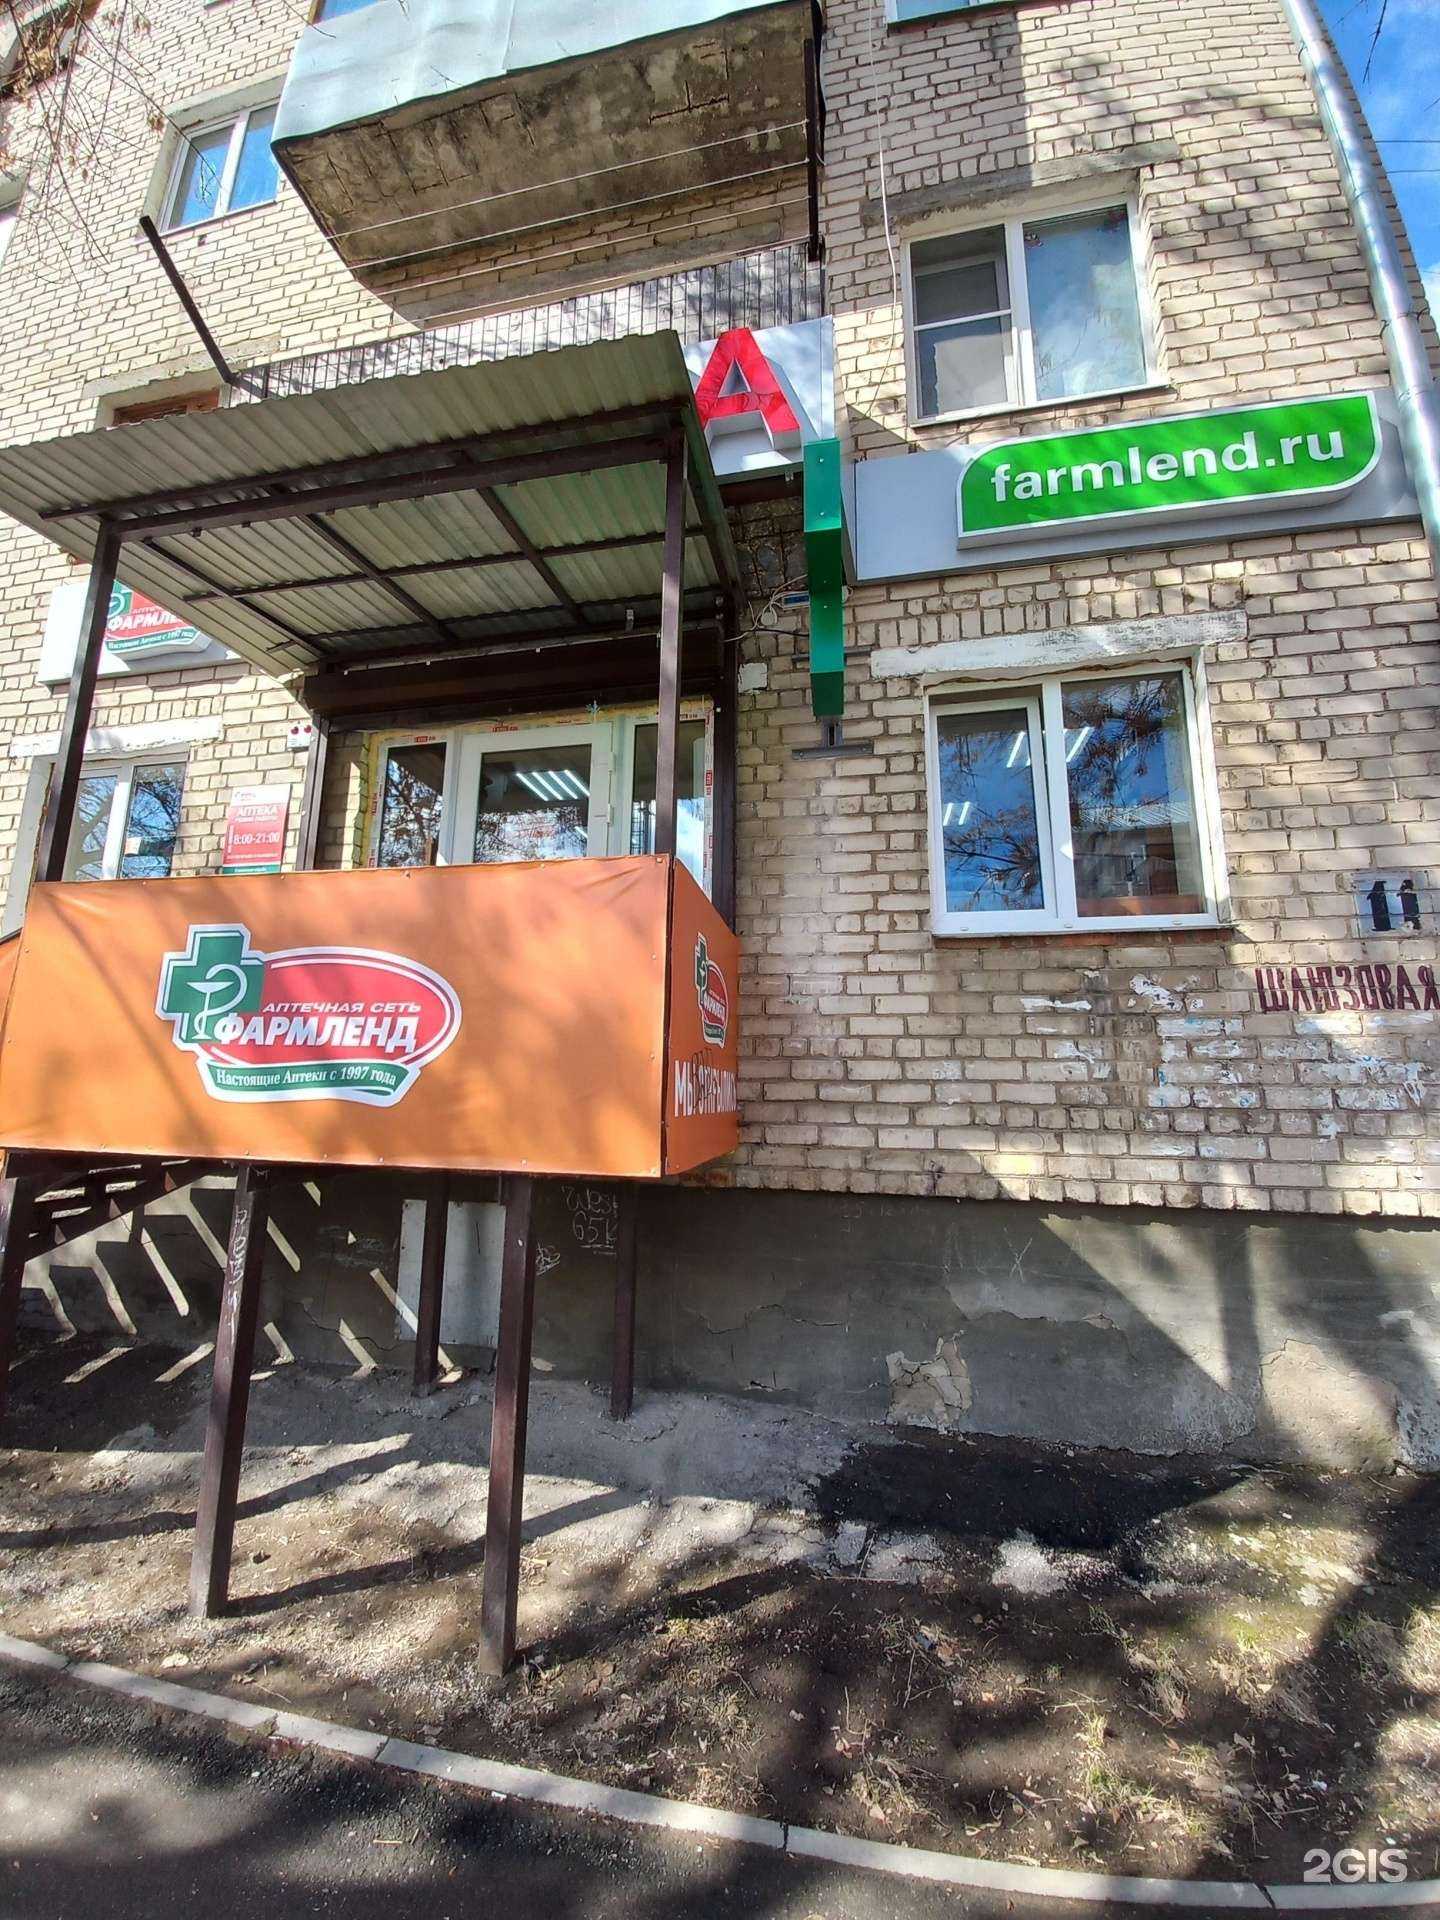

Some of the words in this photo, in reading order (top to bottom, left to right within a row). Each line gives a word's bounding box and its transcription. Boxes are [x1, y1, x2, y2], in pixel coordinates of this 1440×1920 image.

[694, 327, 801, 434] А
[990, 431, 1345, 502] farmlend.ru
[1366, 878, 1424, 932] 11
[263, 1002, 364, 1013] АПТЕЧНАЯ
[370, 1002, 422, 1013] СЕТЬ
[213, 1012, 419, 1054] ФАРМЛЕНД
[216, 1067, 281, 1087] Настоящие
[282, 1069, 327, 1084] Аптеки
[329, 1070, 338, 1081] с
[340, 1065, 369, 1080] 1997
[370, 1068, 397, 1086] года
